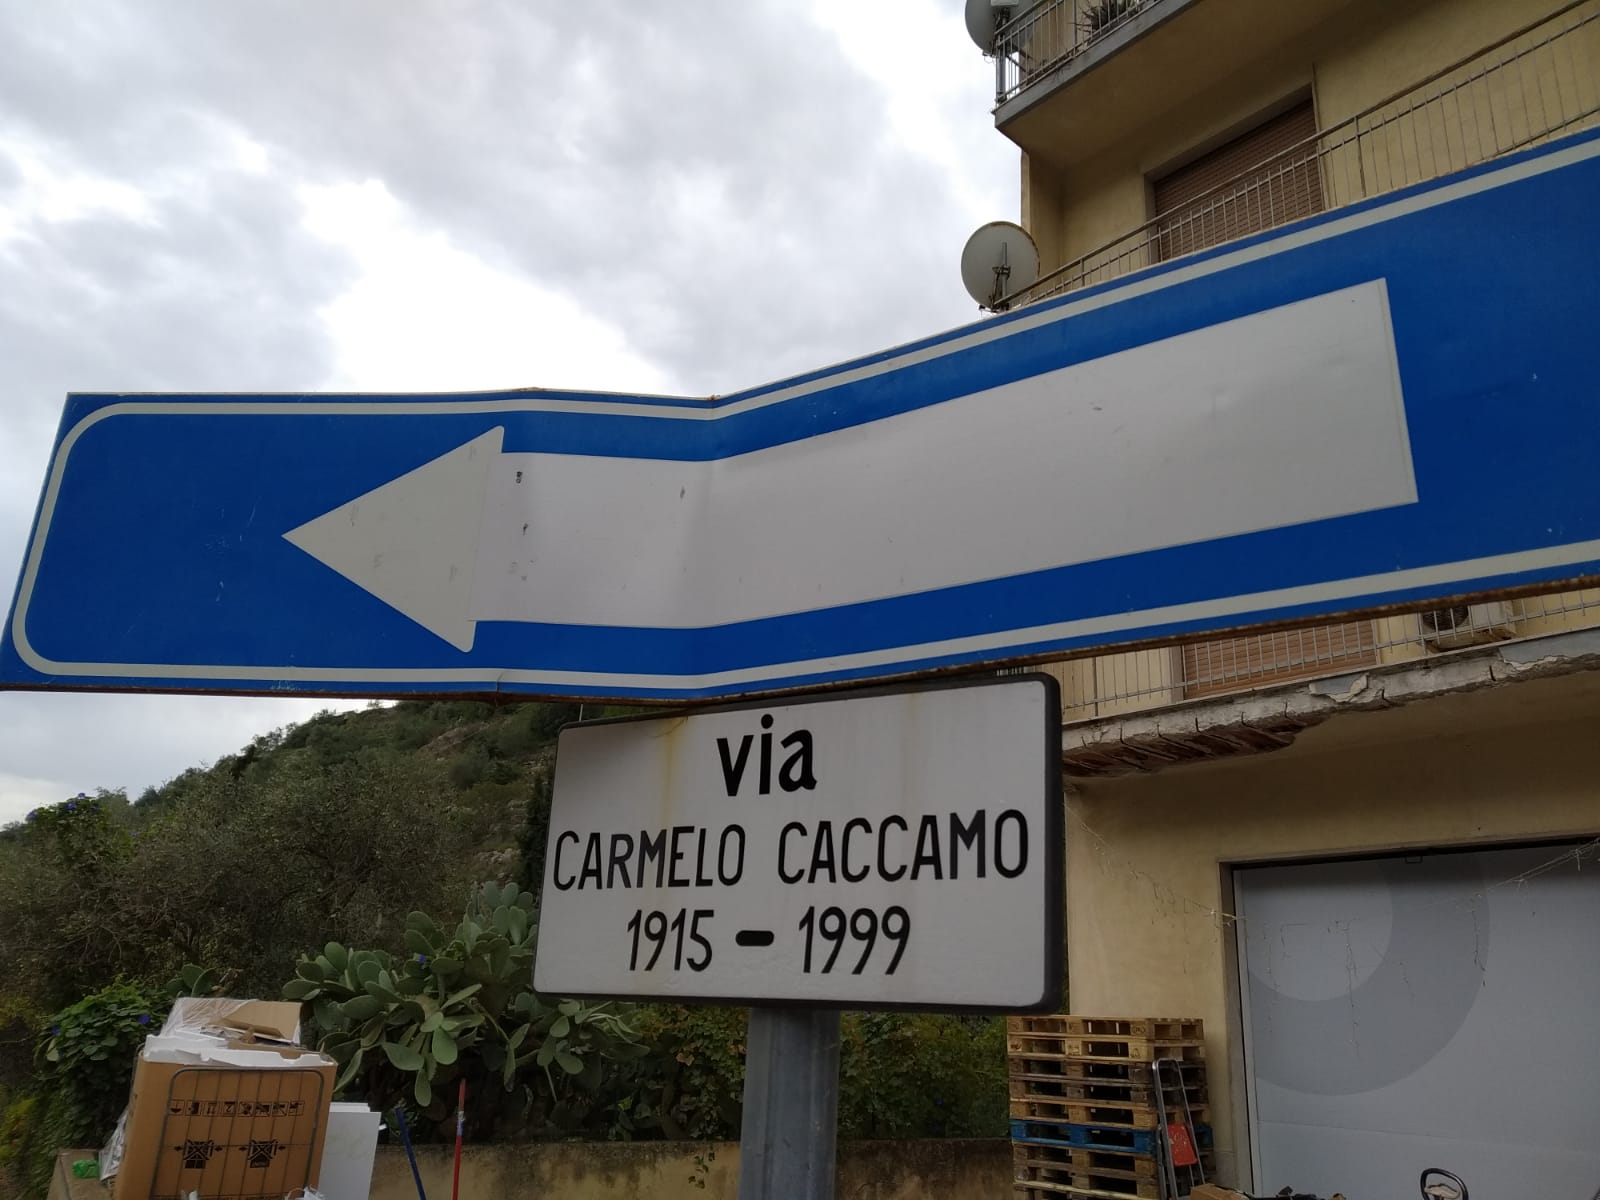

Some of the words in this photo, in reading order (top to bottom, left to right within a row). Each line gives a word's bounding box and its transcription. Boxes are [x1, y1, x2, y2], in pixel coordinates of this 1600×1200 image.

[716, 713, 817, 797] via
[553, 823, 746, 891] CARMELO
[777, 809, 1029, 885] CACCAMO
[627, 908, 715, 972] 1915
[798, 905, 911, 976] 1999
